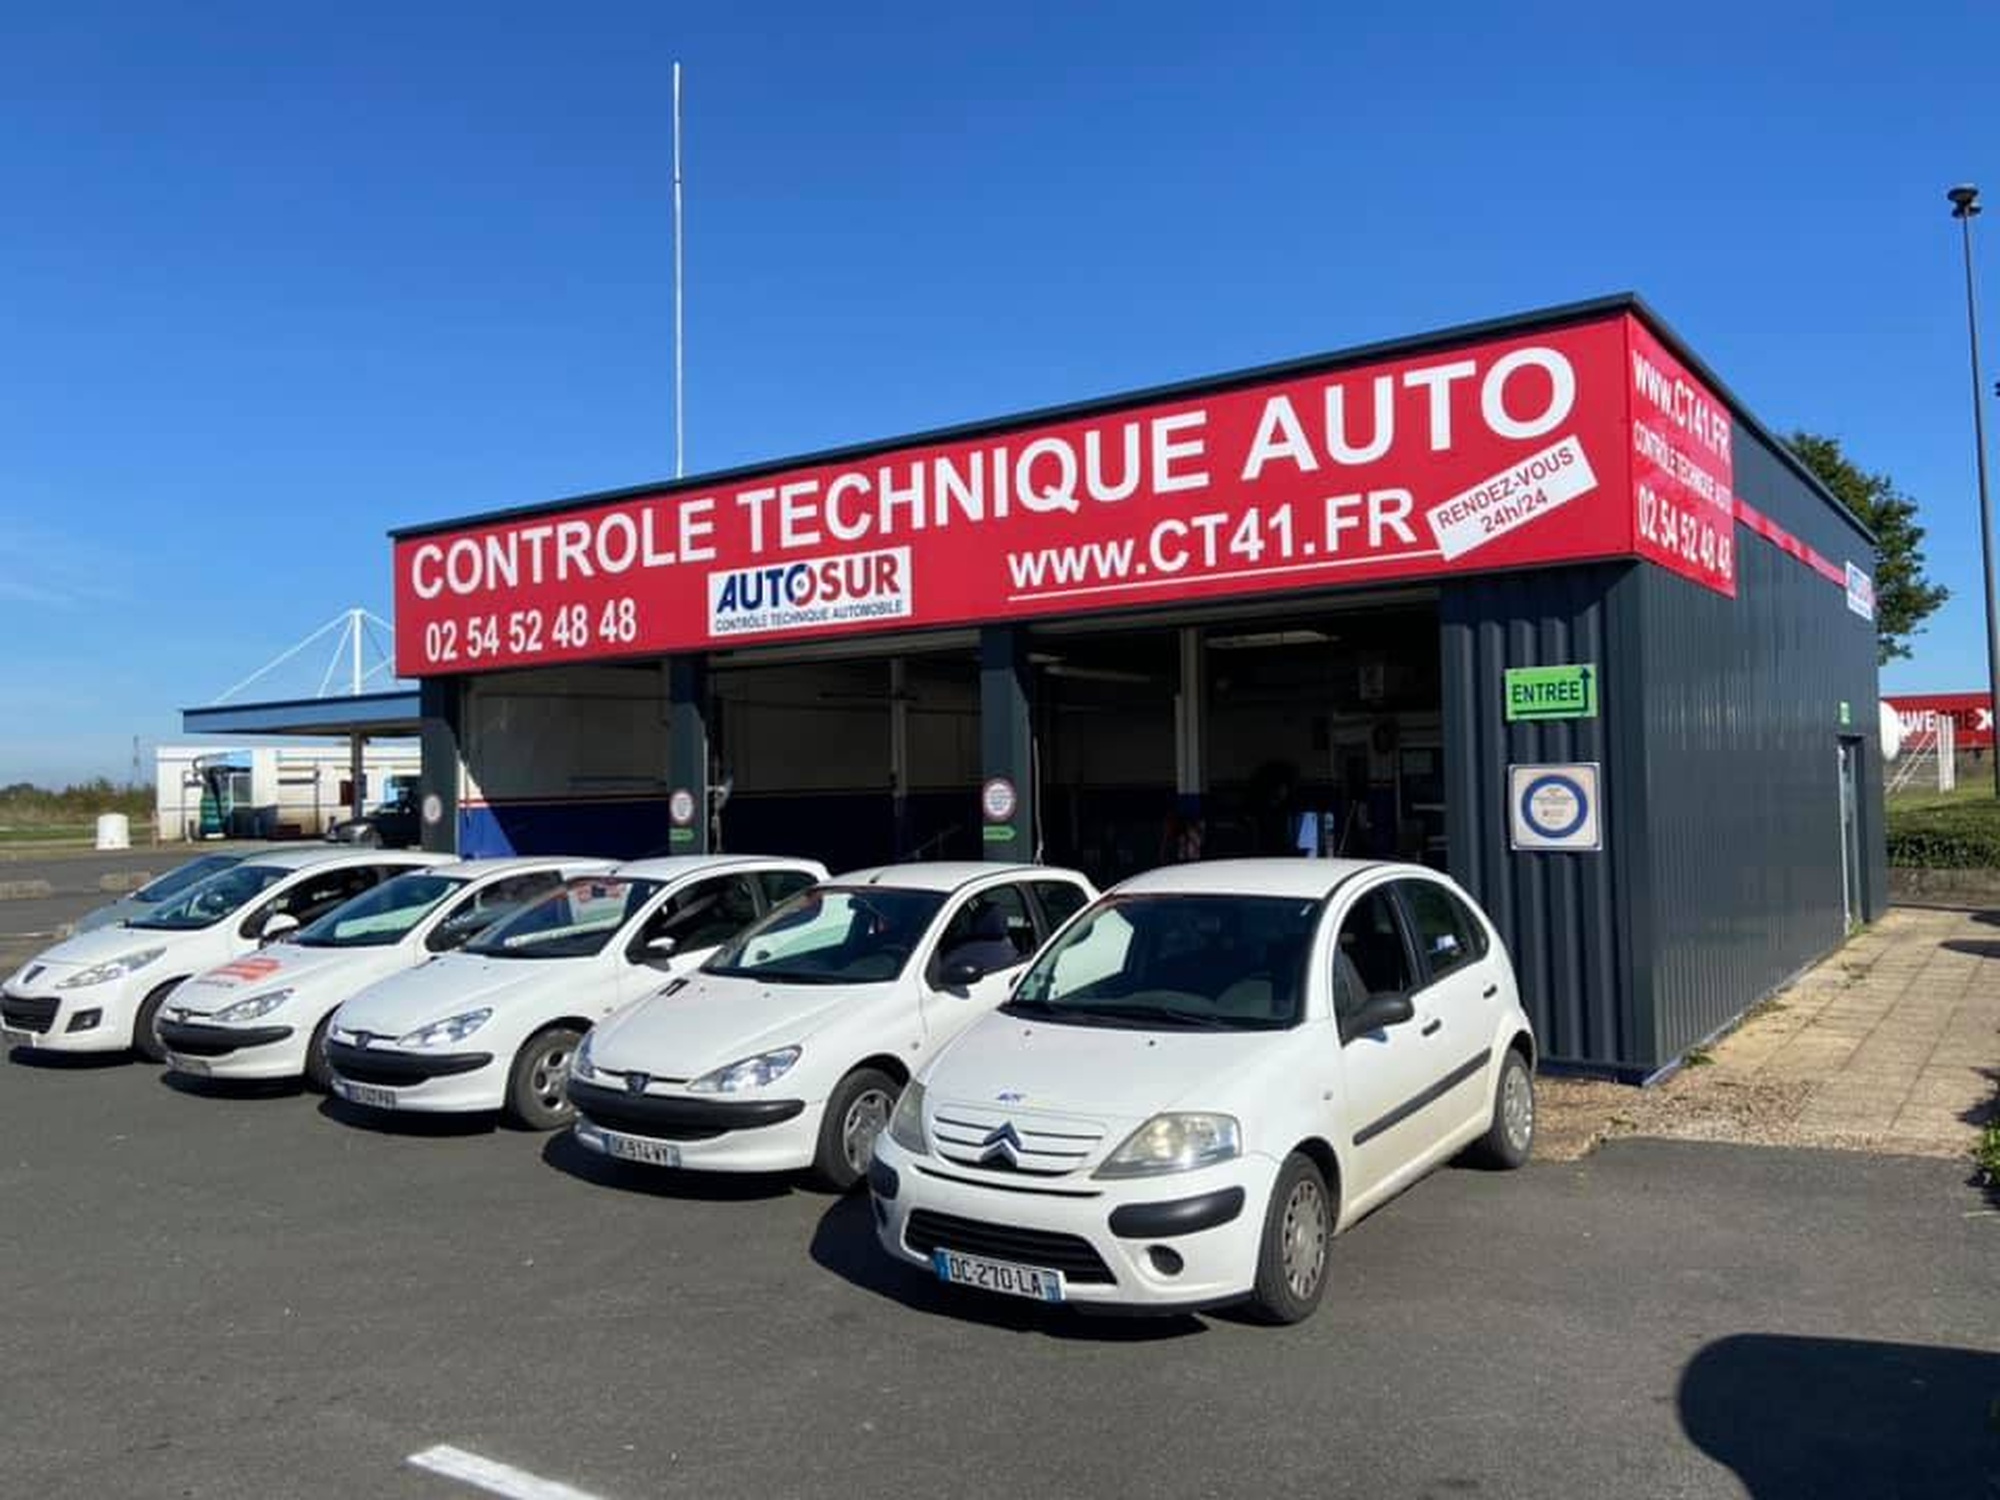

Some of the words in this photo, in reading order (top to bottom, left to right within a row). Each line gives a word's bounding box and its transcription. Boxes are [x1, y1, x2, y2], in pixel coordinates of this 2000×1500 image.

[412, 498, 715, 599] CONTROLE
[737, 410, 1210, 552] TECHNIQUE
[1241, 347, 1577, 481] AUTO
[1437, 447, 1574, 529] RENDEZ-VOUS
[1481, 488, 1548, 533] 24h/24
[1638, 484, 1657, 543] 02
[1661, 499, 1678, 554] 54
[1681, 513, 1698, 563] 52
[716, 554, 900, 613] AUTOSUR
[771, 607, 828, 625] TECHNIQUE
[833, 599, 901, 619] AUTOMOBILE
[425, 619, 457, 664] 02
[467, 613, 499, 658] 54
[509, 607, 542, 653] 52
[552, 603, 589, 647] 48
[600, 597, 636, 642] 48
